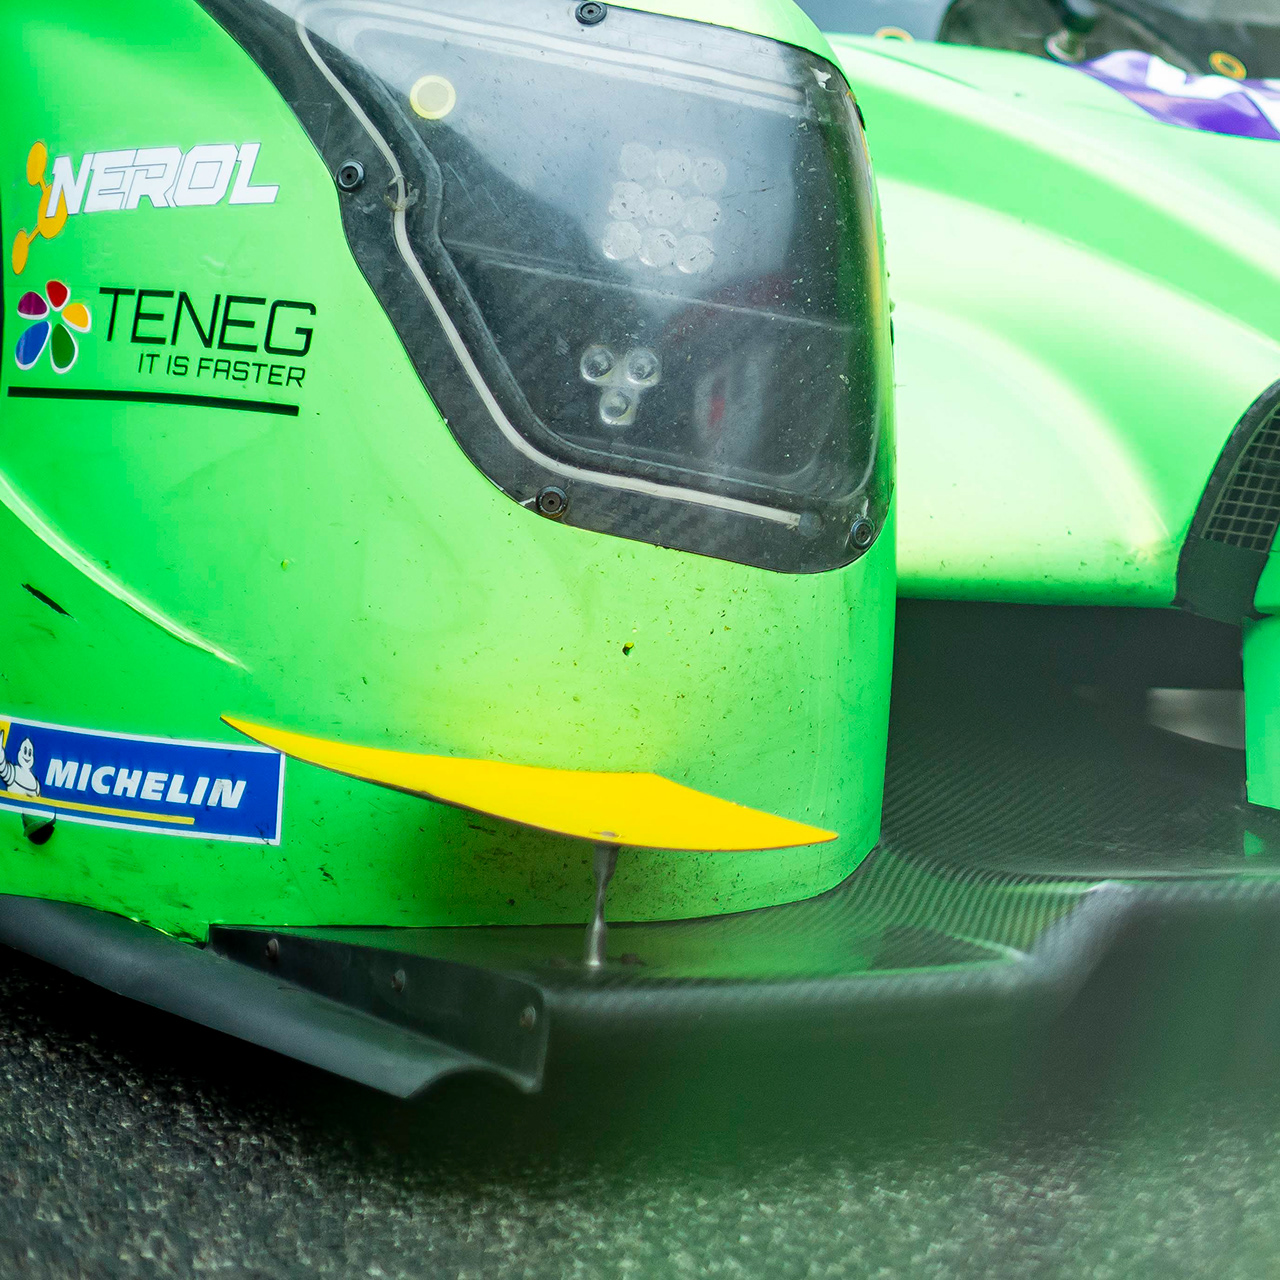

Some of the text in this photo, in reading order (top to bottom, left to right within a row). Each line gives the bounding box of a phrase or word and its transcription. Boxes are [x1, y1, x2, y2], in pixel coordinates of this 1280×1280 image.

[45, 141, 281, 219] NEROL
[99, 286, 318, 358] TENEG
[138, 353, 307, 389] IT IS FASTER
[44, 757, 248, 810] MICHELIN
